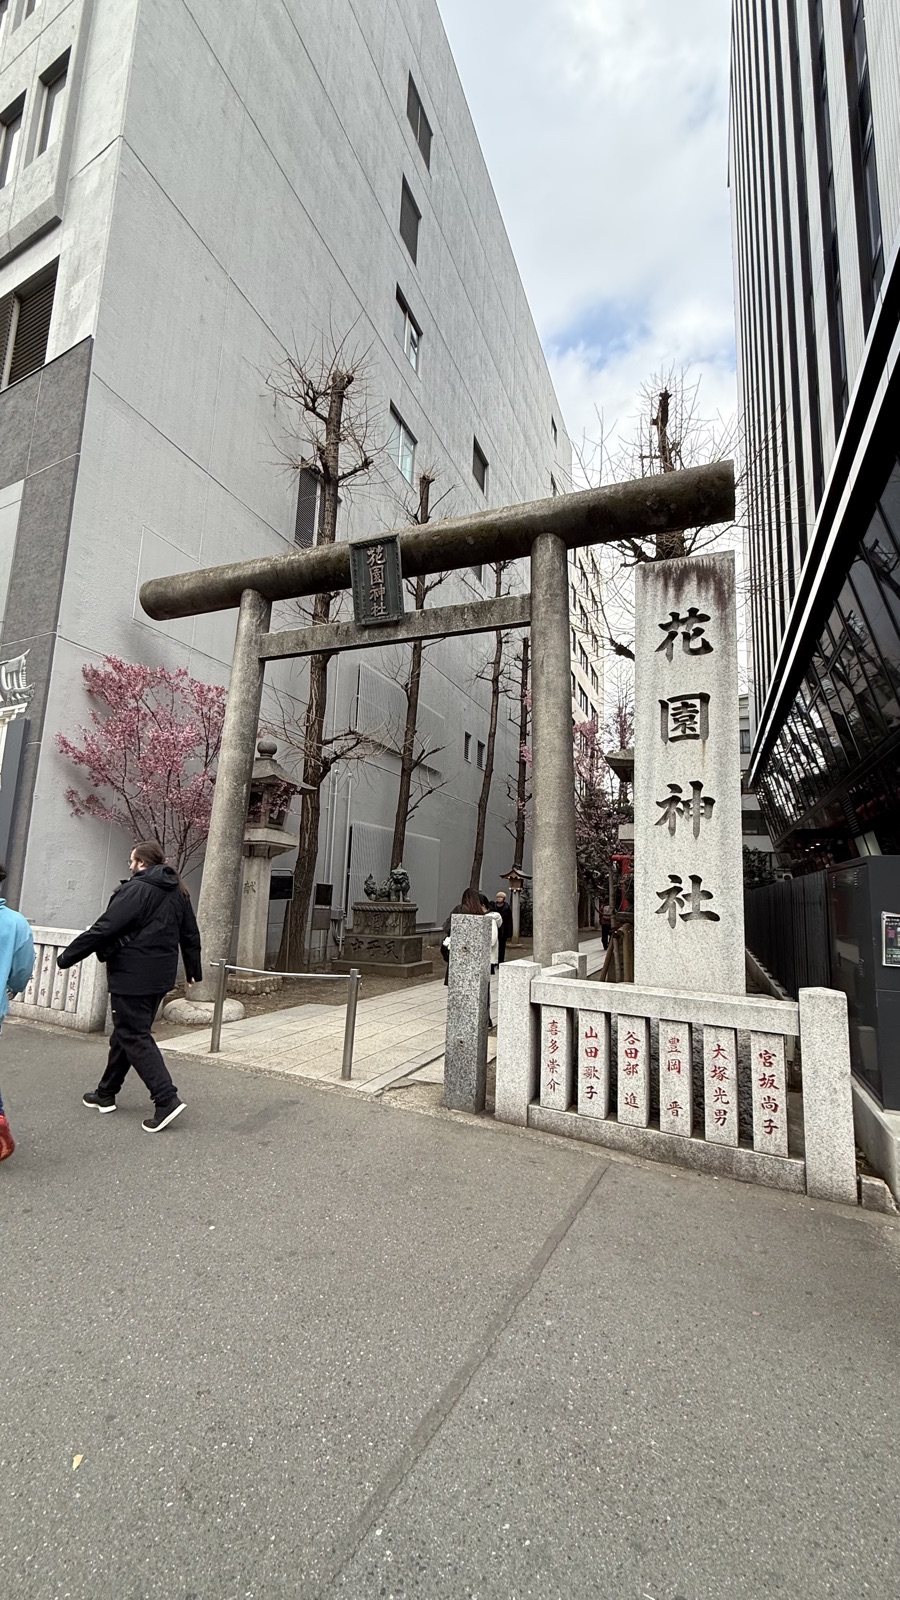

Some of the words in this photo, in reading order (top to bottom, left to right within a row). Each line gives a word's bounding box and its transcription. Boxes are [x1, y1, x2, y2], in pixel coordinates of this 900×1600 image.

[366, 545, 388, 617] 花園神社
[655, 606, 720, 930] 花園神社
[583, 1025, 600, 1100] 山田歌子
[711, 1043, 730, 1127] 大塚光男
[758, 1049, 780, 1135] 宮坂尚子
